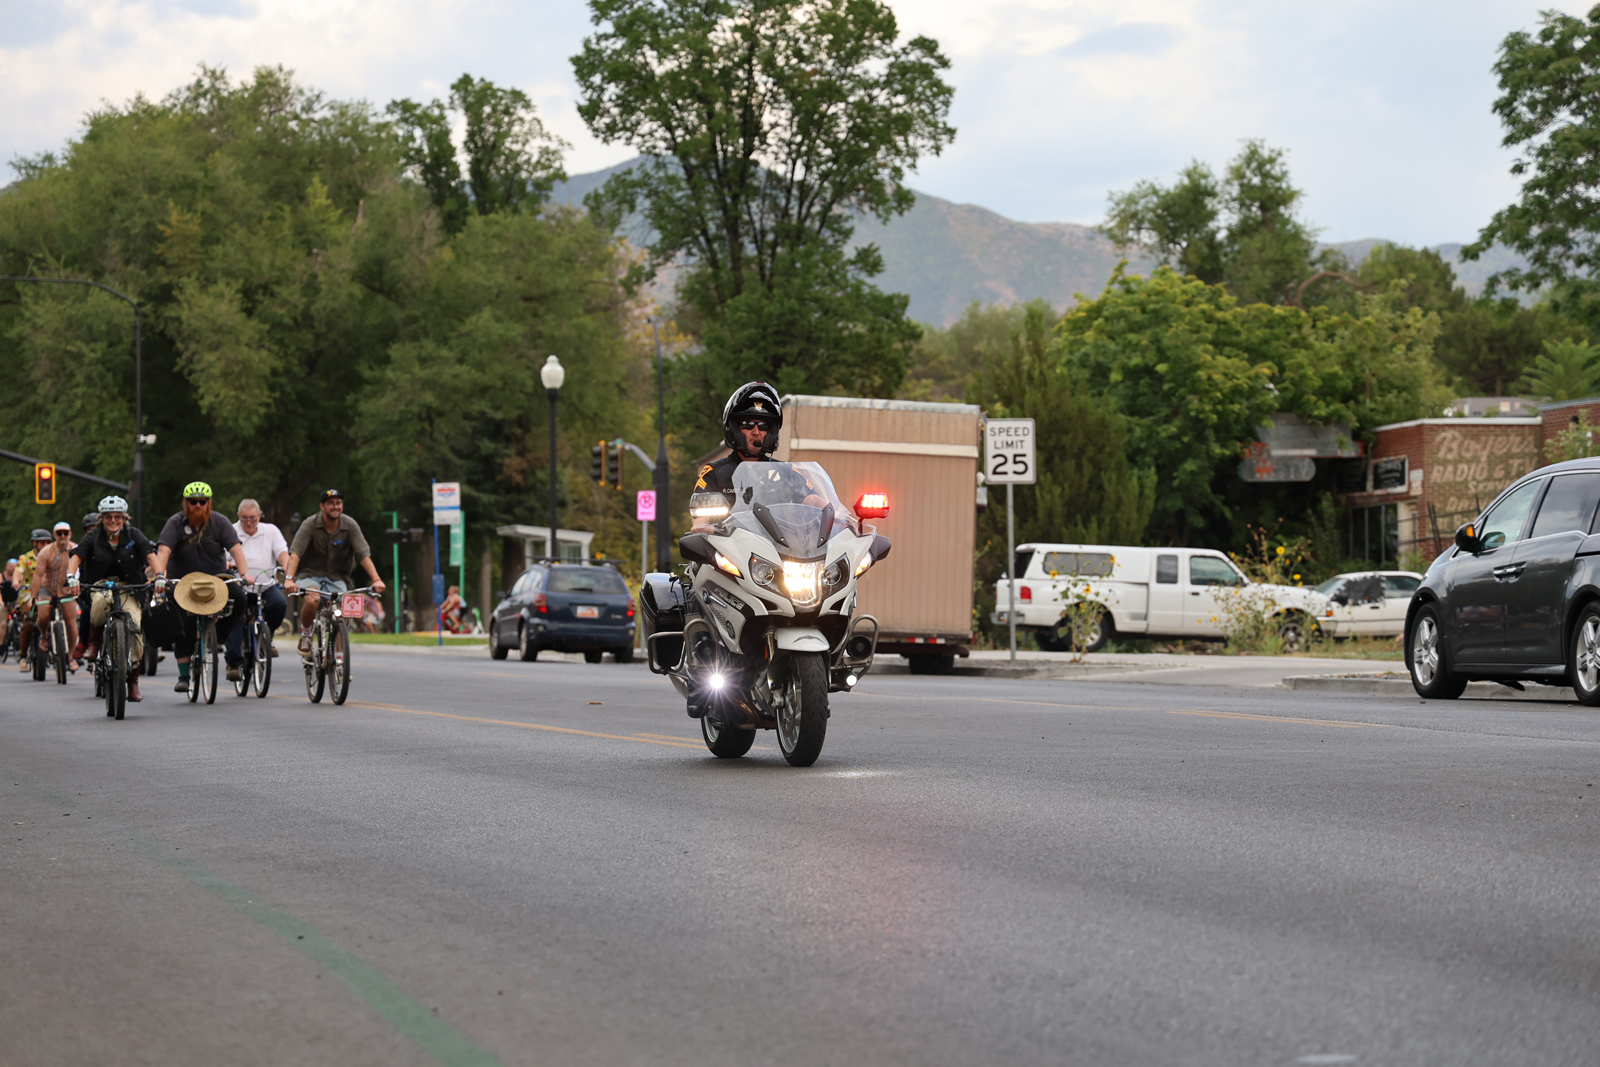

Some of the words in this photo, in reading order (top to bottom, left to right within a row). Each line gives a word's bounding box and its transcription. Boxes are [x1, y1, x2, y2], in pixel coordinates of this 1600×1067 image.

[990, 427, 1030, 437] SPEED
[994, 440, 1025, 449] LIMIT
[992, 453, 1029, 475] 25
[1431, 462, 1488, 483] RADIO
[714, 587, 745, 610] POLICE
